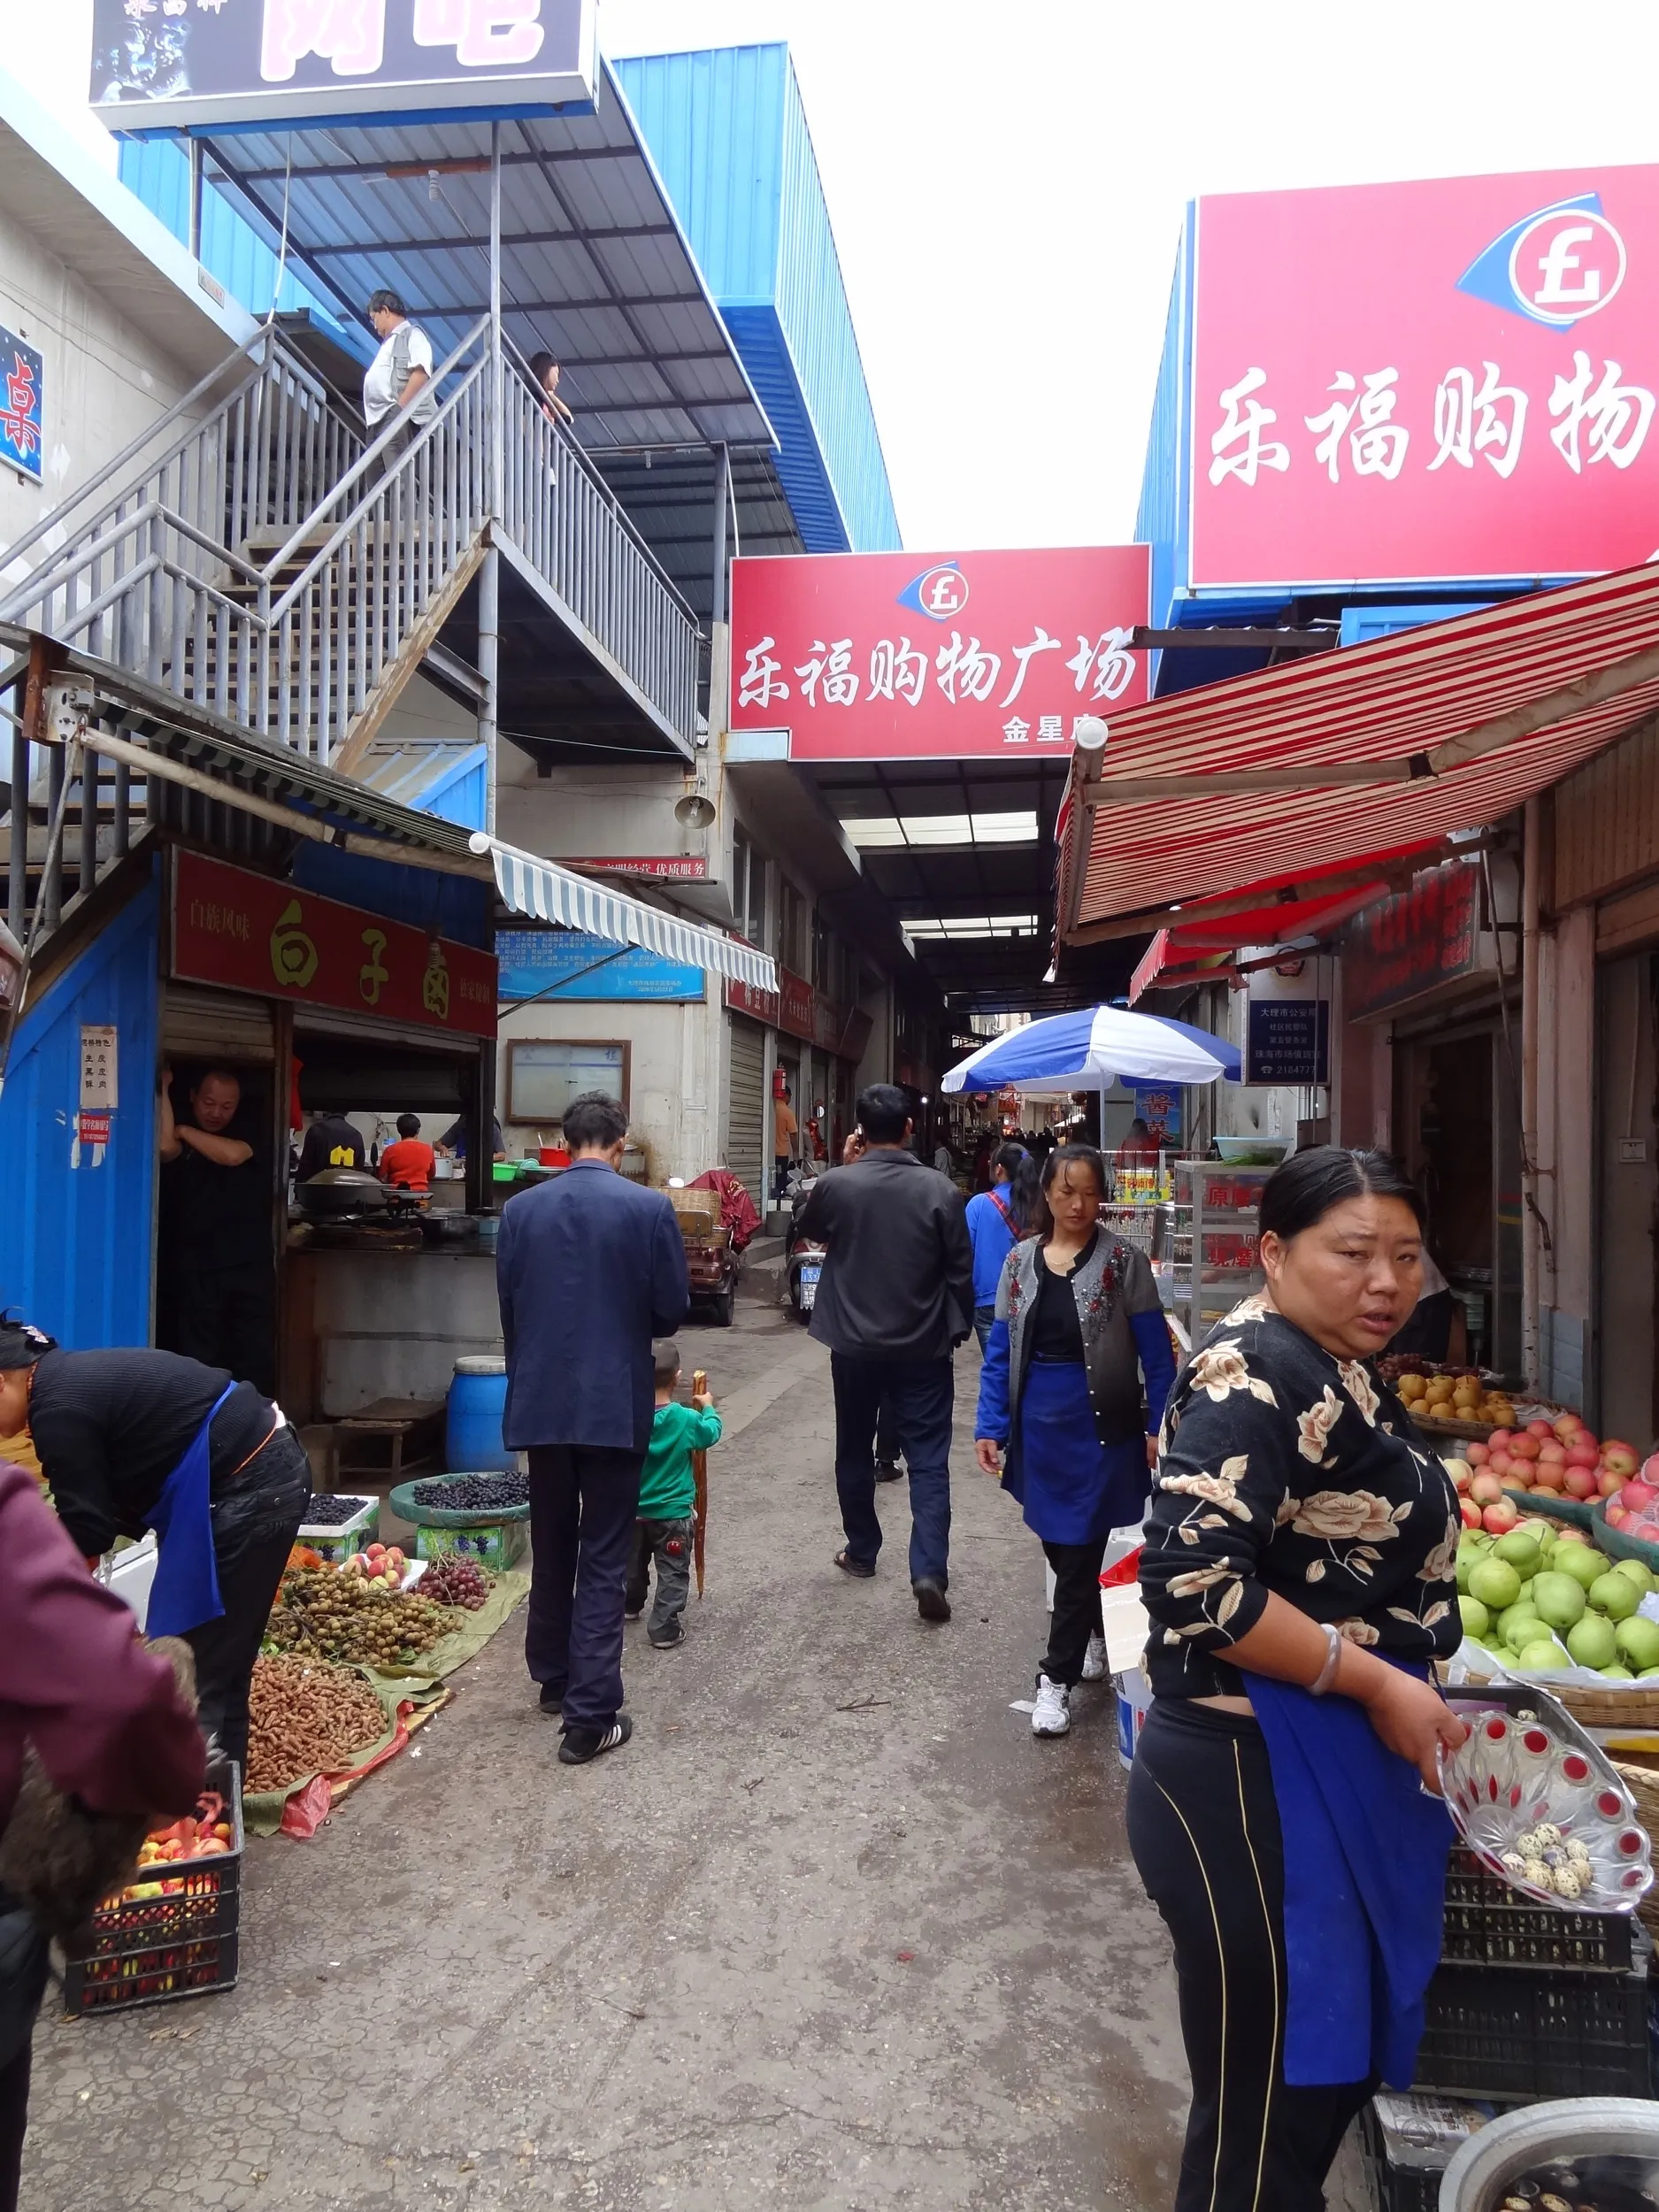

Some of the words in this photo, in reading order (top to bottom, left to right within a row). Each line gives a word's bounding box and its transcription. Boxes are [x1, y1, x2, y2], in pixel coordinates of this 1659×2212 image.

[1209, 349, 1656, 487] 乐福购物
[738, 626, 1136, 709] 乐福购物广场
[657, 862, 705, 876] 优质服务
[189, 898, 250, 943] 白族风味
[1260, 1007, 1317, 1018] 大理市公安局
[1141, 1086, 1177, 1143] 酱菜
